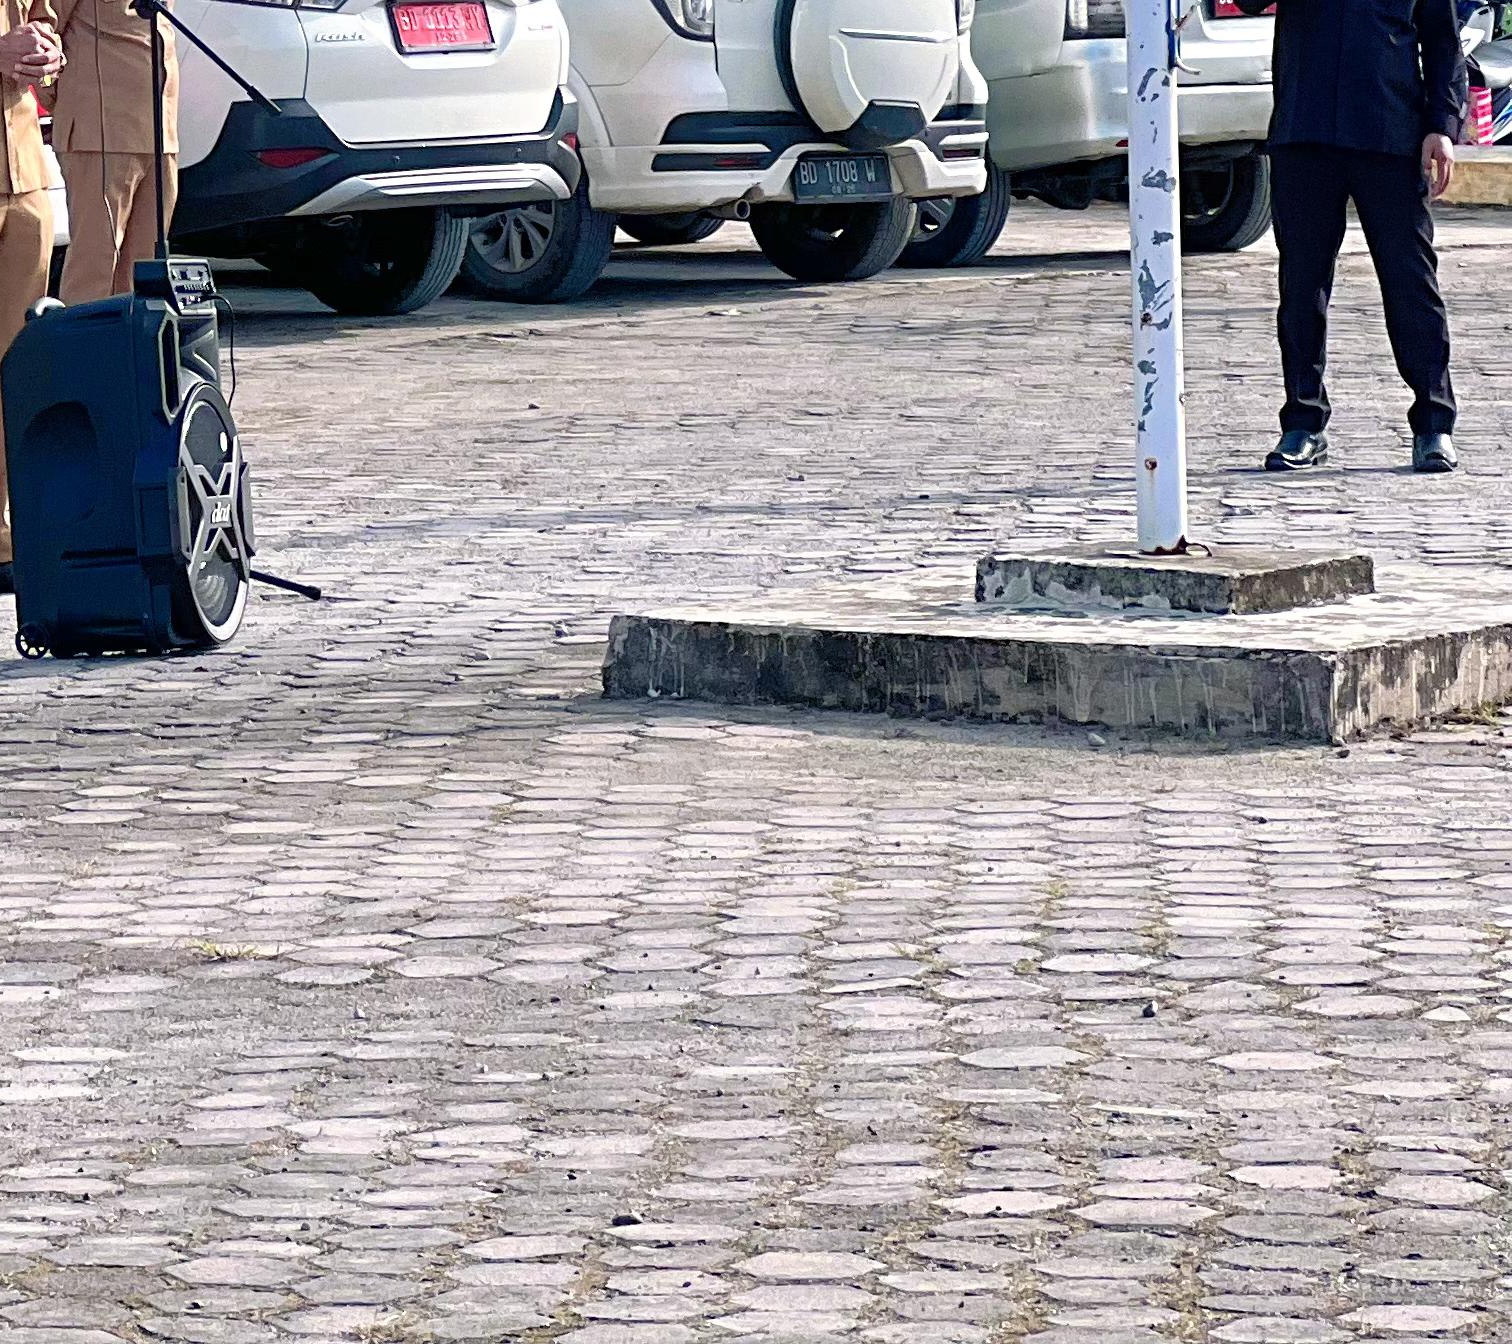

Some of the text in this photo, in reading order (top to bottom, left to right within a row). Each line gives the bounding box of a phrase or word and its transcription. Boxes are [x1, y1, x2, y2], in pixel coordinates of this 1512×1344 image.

[799, 159, 876, 185] BD 1708 W
